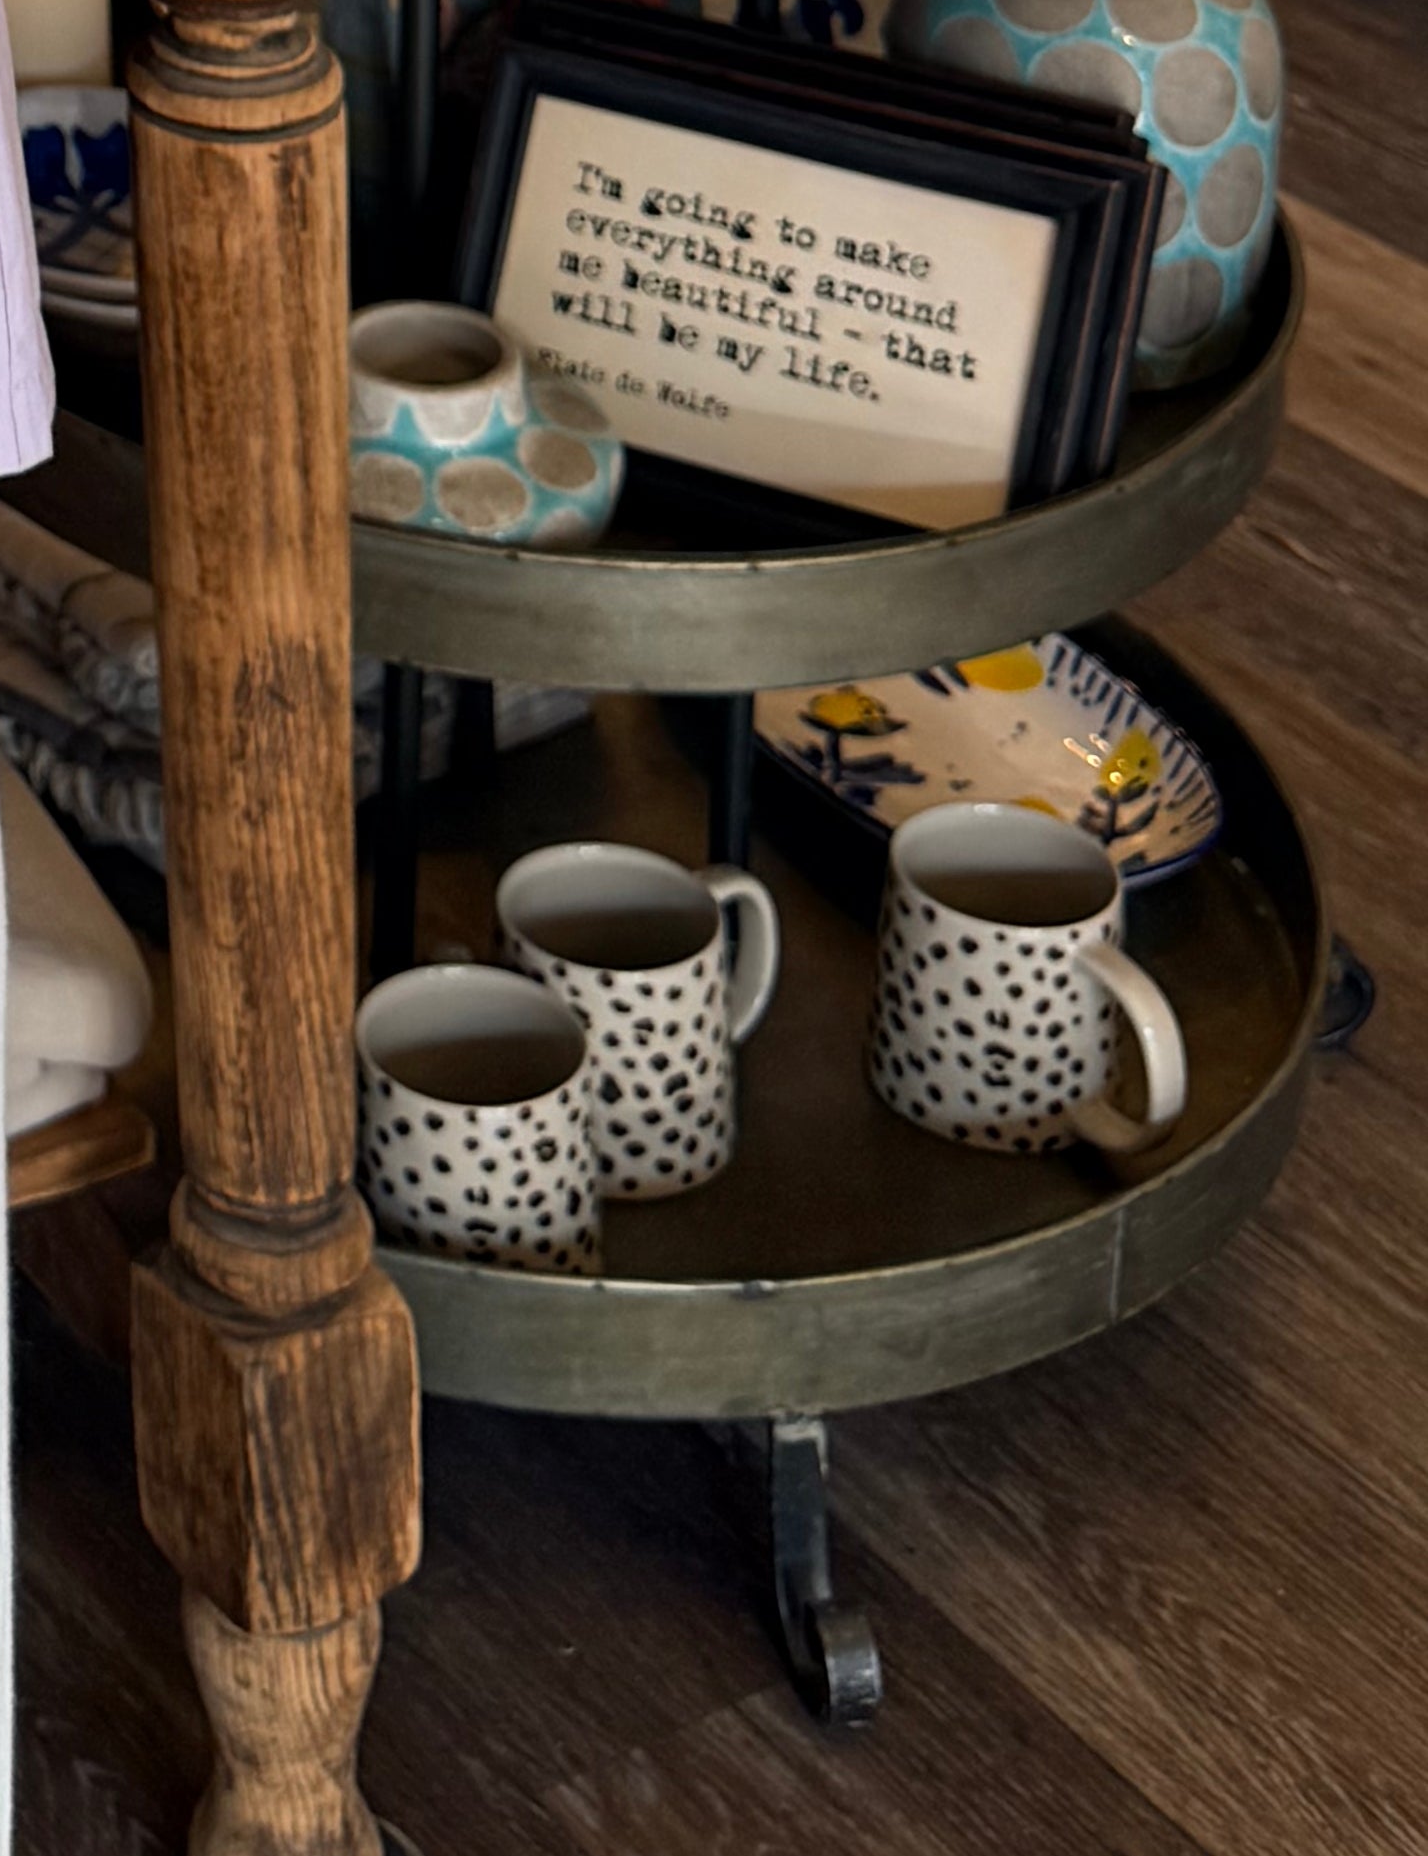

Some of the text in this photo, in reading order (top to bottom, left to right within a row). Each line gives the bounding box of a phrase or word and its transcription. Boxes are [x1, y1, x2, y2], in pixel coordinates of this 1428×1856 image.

[565, 207, 959, 333] everything around
[572, 160, 932, 279] I'm going to make
[551, 289, 880, 402] will be my life.
[559, 249, 604, 281] me
[621, 258, 821, 341] beautiful
[882, 331, 977, 380] that
